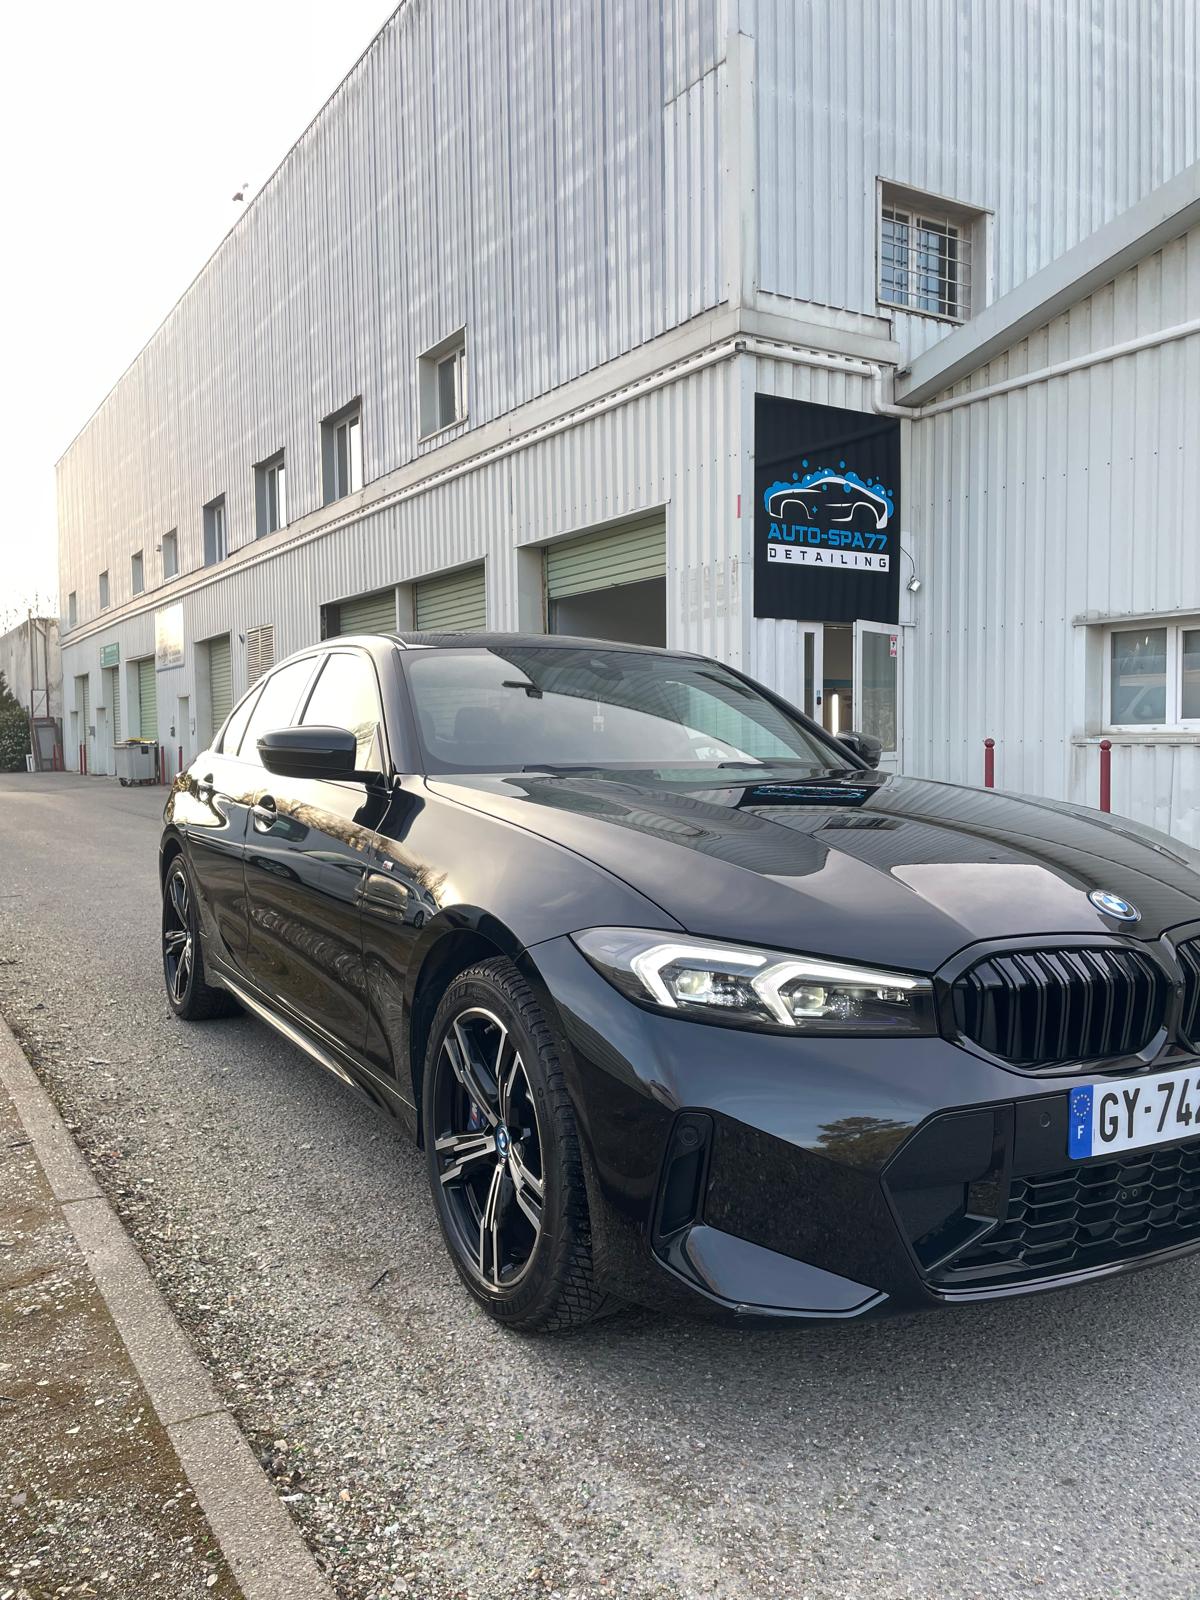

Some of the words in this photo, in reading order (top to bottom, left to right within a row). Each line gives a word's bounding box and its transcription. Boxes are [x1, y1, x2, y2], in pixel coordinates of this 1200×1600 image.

[768, 523, 887, 550] AUTO-SPA77
[769, 548, 886, 567] DETAILING
[1077, 1125, 1084, 1139] F
